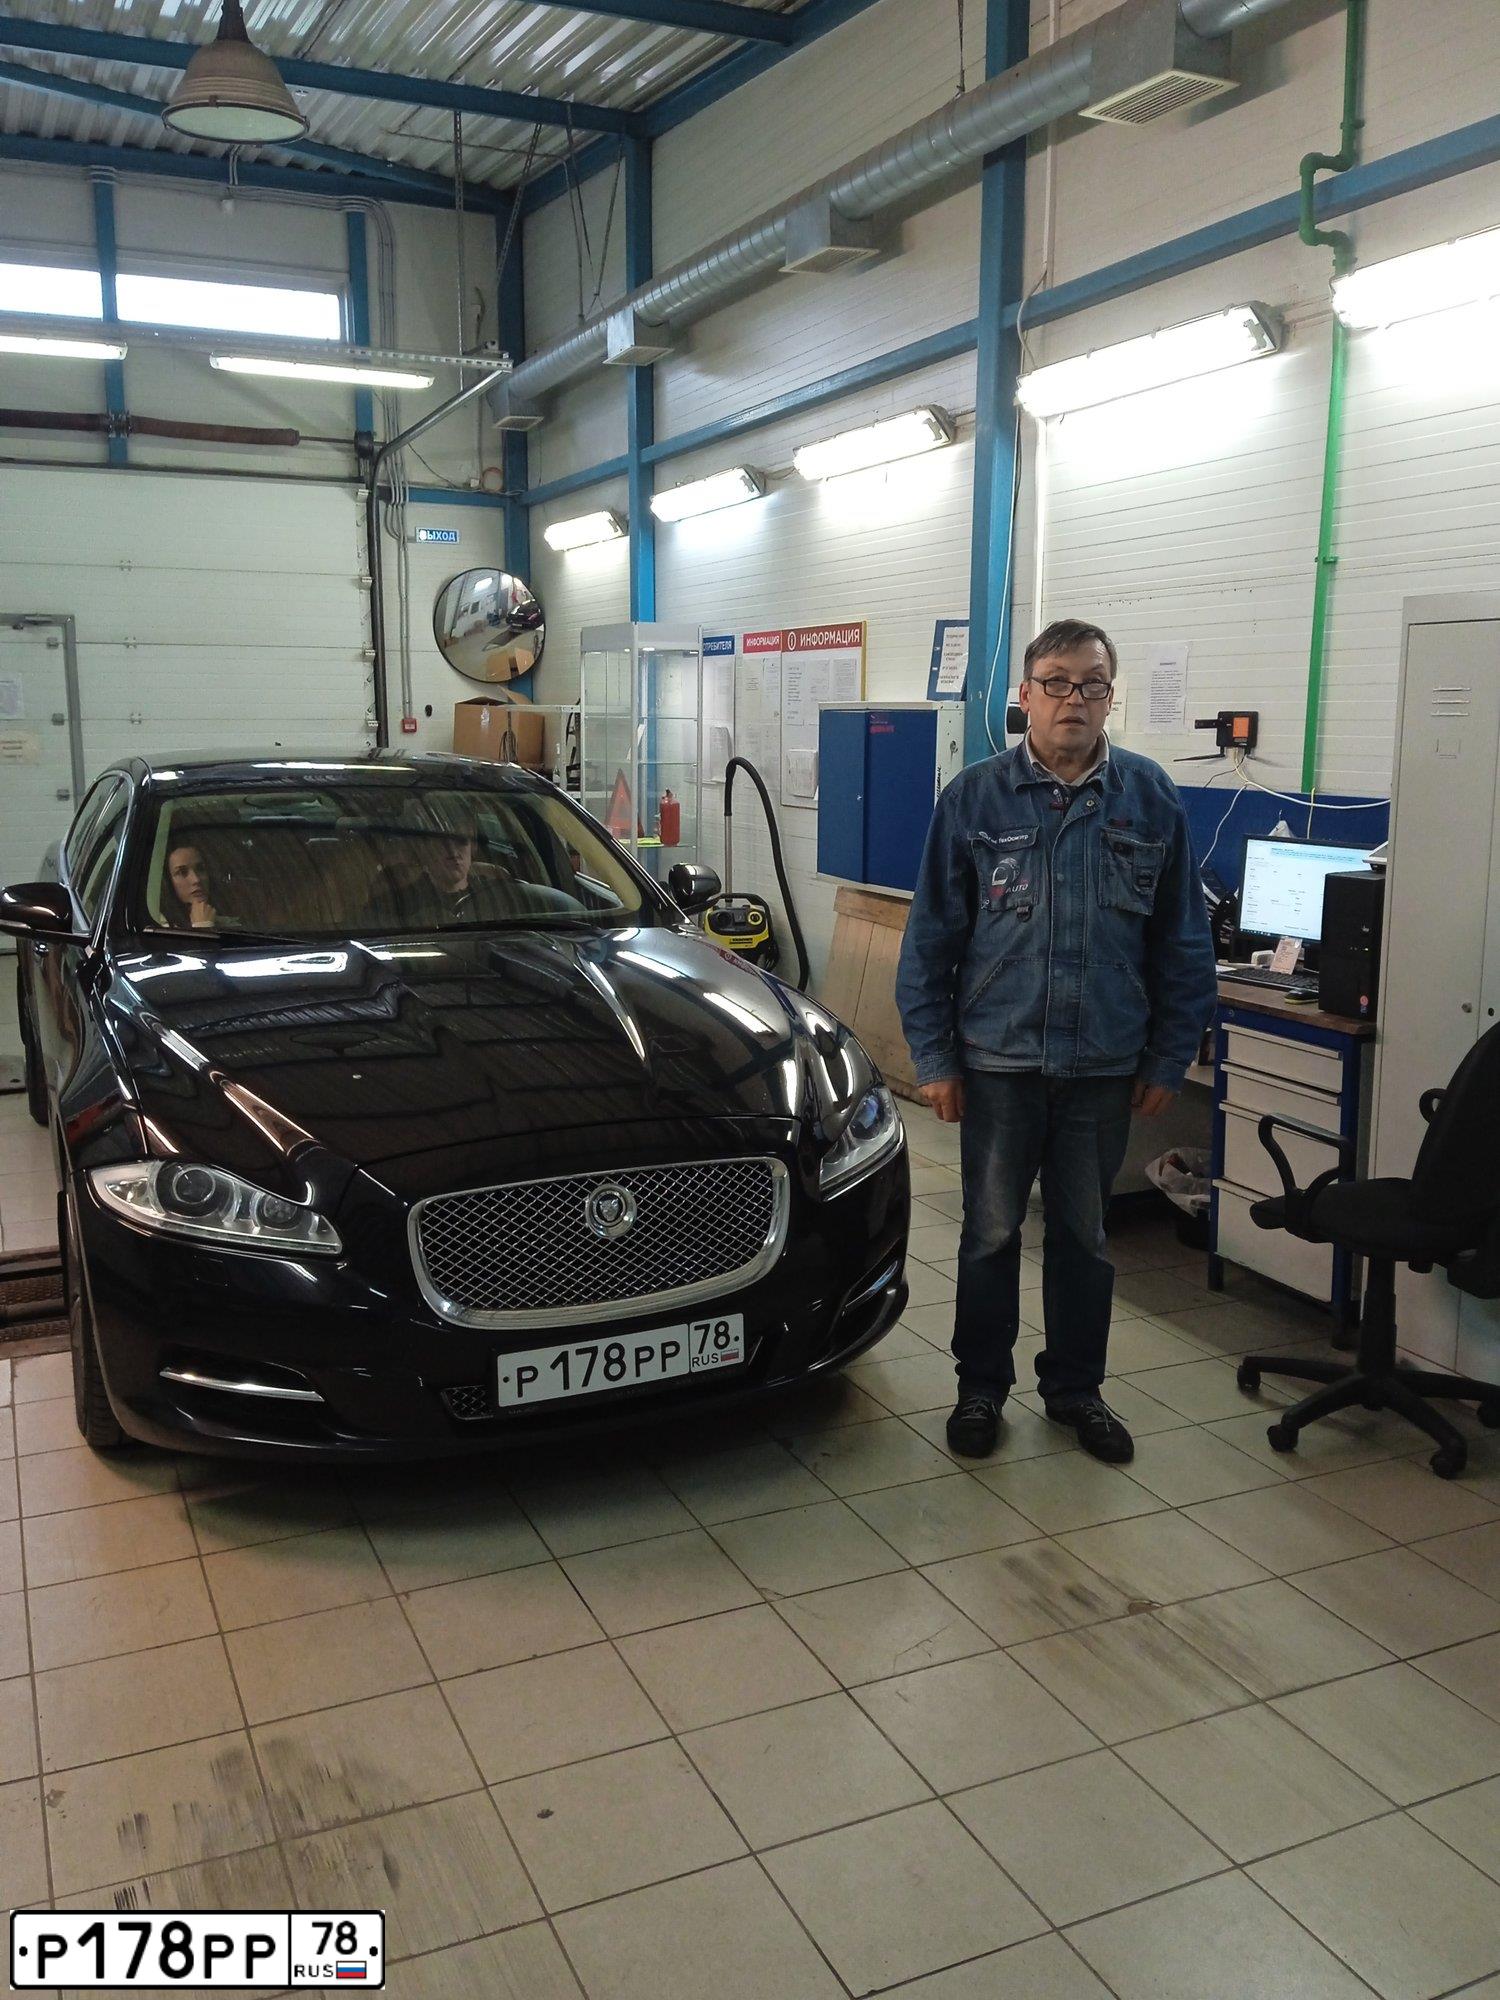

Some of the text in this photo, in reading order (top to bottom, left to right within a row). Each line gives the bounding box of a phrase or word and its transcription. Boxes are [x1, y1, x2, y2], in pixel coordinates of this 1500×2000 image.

[419, 529, 456, 541] ЫХОД
[746, 635, 780, 647] ИНФОРМАЦИЯ
[800, 628, 860, 646] ИНФОРМАЦИЯ
[694, 1320, 730, 1355] 78
[691, 1352, 719, 1368] RUS
